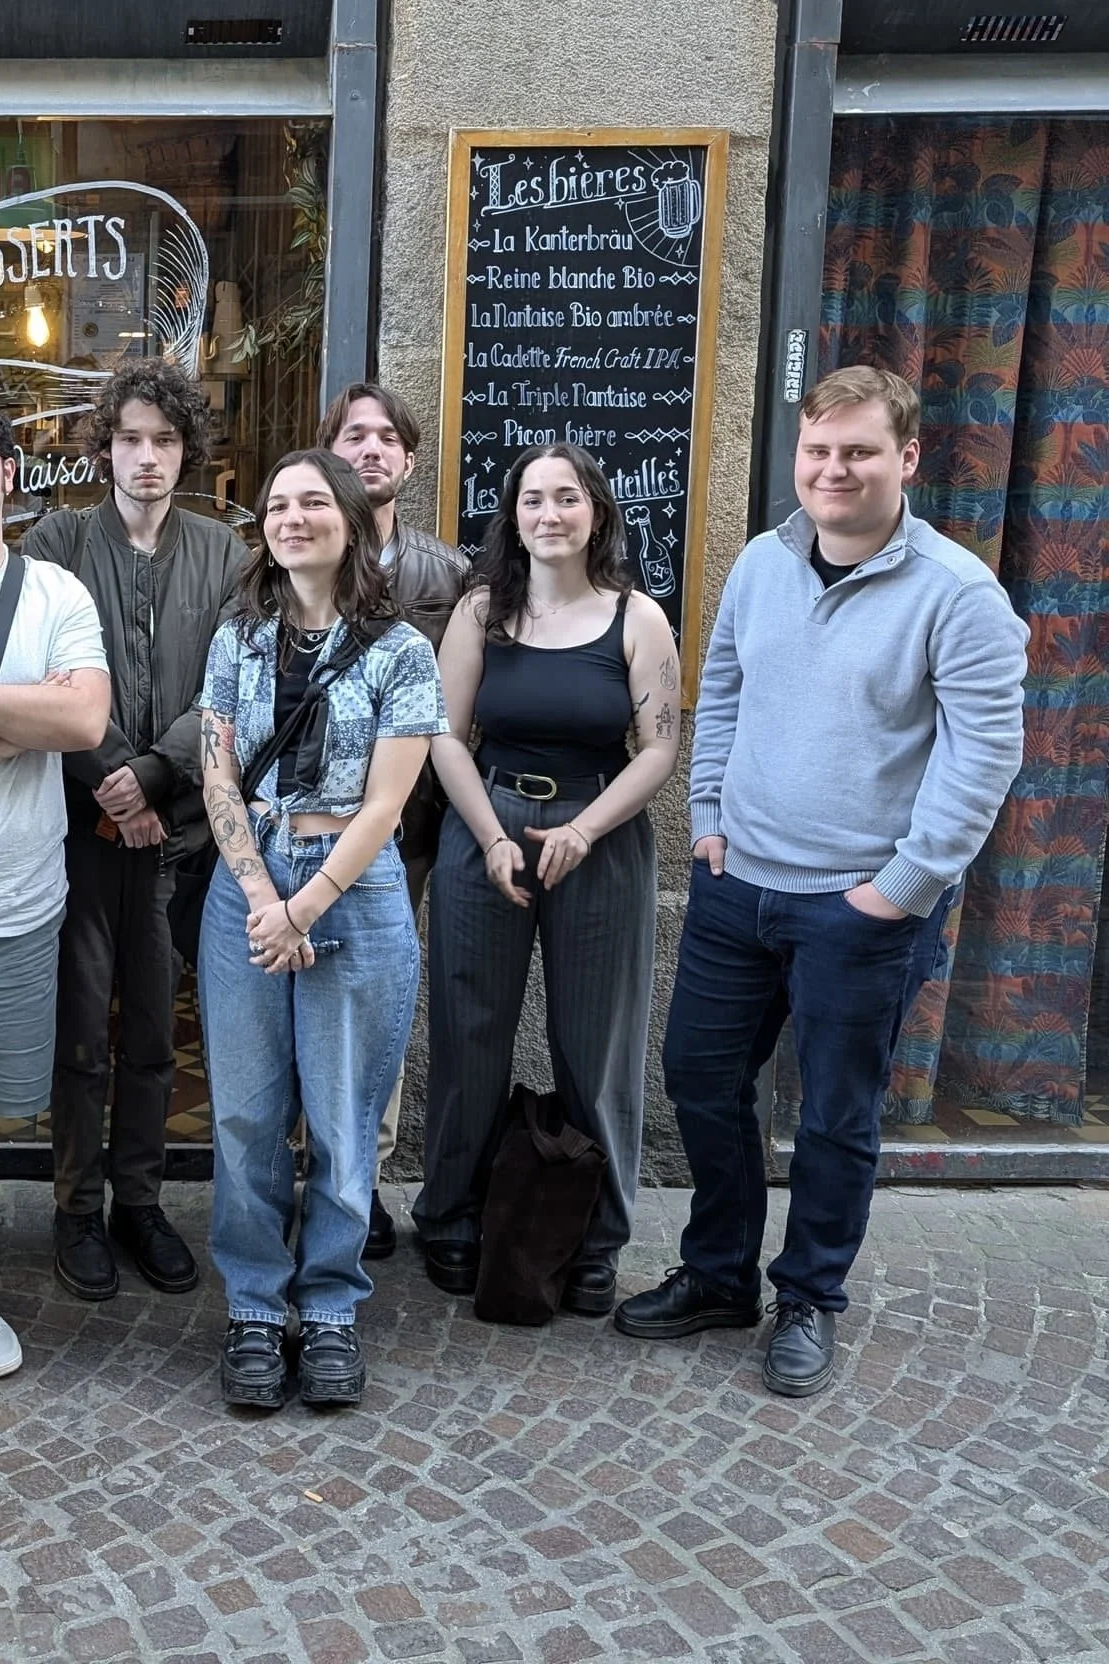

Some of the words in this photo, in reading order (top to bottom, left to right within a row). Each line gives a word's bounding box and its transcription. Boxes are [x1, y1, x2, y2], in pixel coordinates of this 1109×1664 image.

[479, 154, 544, 217] Les
[545, 155, 647, 208] bières
[493, 229, 515, 253] La
[525, 224, 633, 252] Kanterbräu
[486, 265, 541, 290] Reine
[548, 266, 616, 290] blanche
[622, 265, 655, 289] Bio
[471, 303, 491, 328] La
[493, 302, 565, 328] Nantaise
[569, 301, 602, 327] Bio
[606, 303, 674, 328] ambrée
[467, 342, 488, 368] La
[490, 342, 550, 369] Cadette
[553, 346, 604, 370] French
[604, 346, 641, 369] Craft
[642, 347, 683, 370] IPA
[487, 381, 508, 407] La
[511, 379, 569, 413] Triple
[572, 382, 647, 409] Nantaise
[503, 418, 556, 447] Picon
[564, 420, 617, 447] bière
[462, 472, 499, 518] Les
